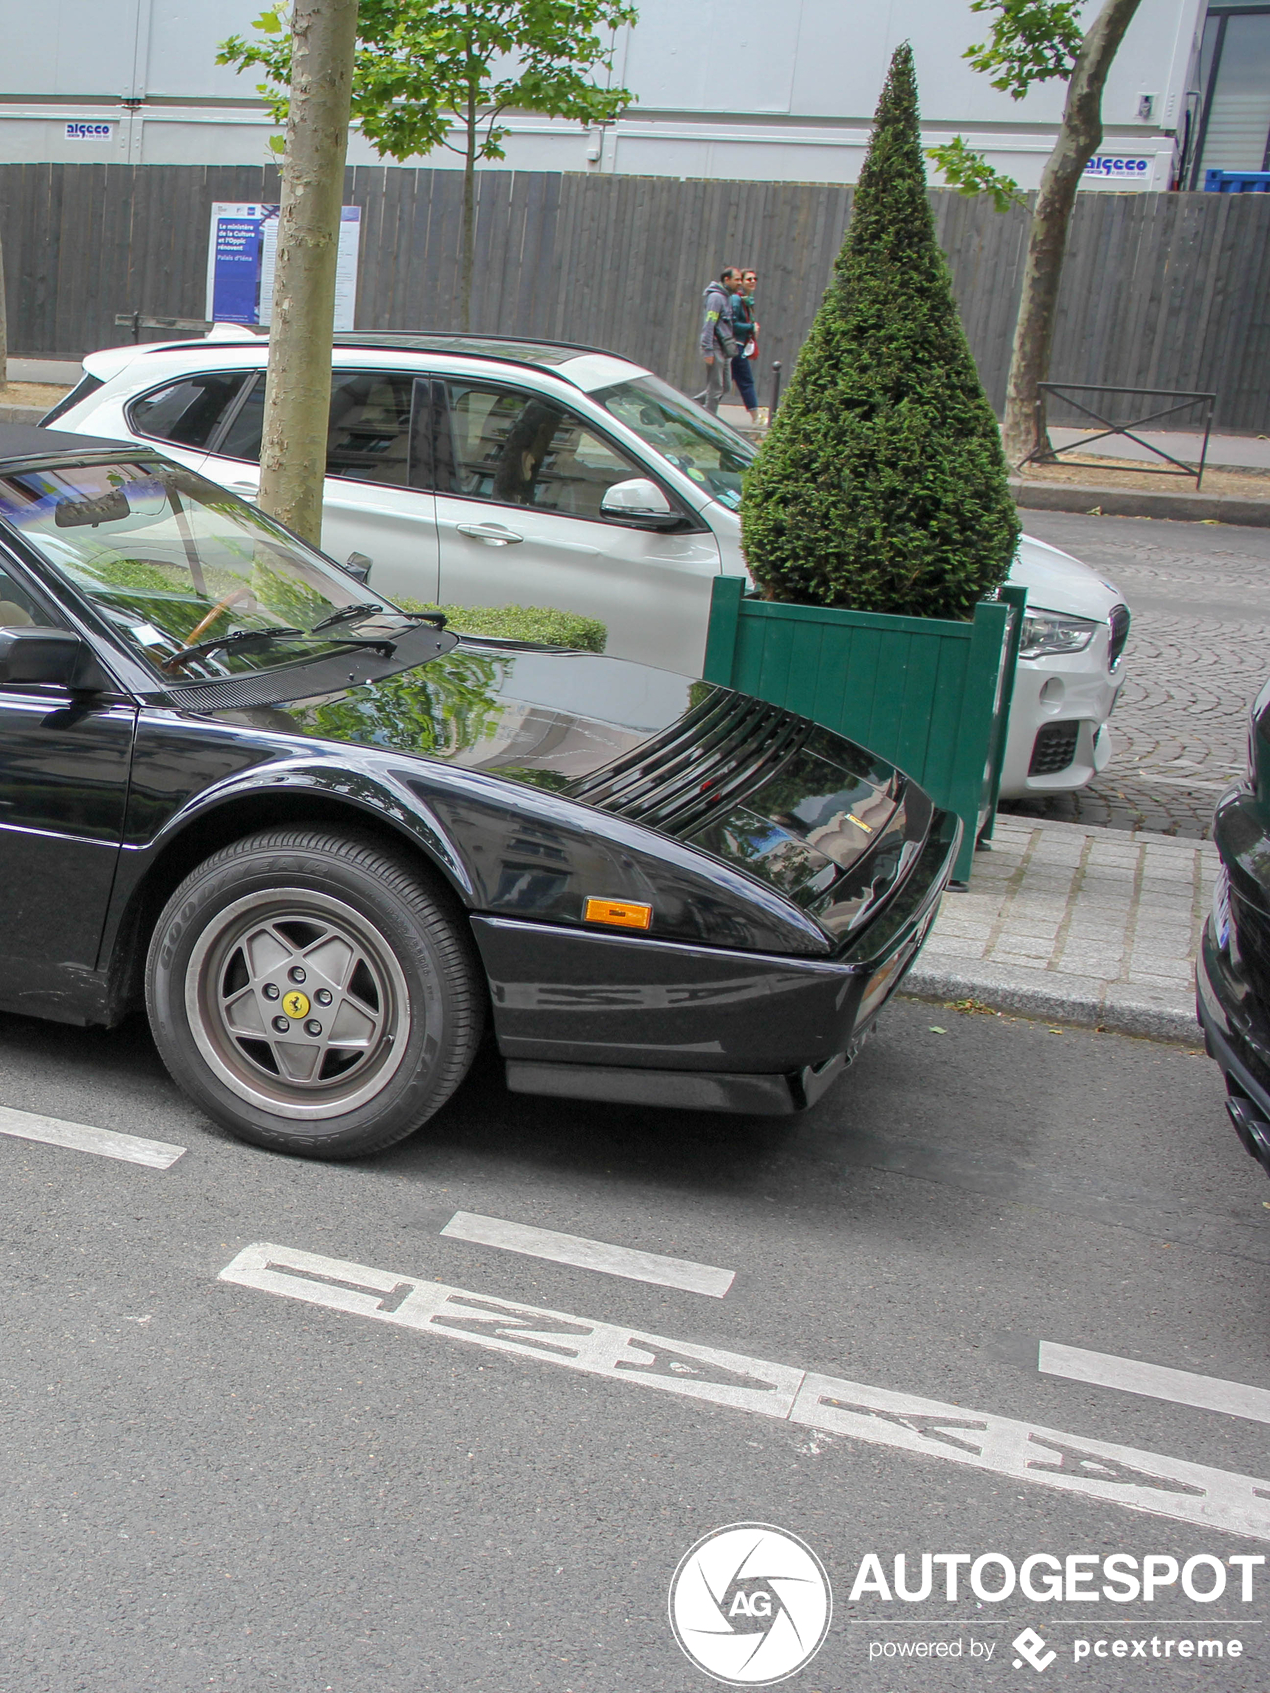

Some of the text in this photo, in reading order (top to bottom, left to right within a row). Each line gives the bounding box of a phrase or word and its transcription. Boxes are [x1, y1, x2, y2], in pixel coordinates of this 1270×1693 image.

[67, 124, 110, 139] algeco
[1085, 157, 1147, 176] algeco
[264, 1259, 1270, 1501] AYANT
